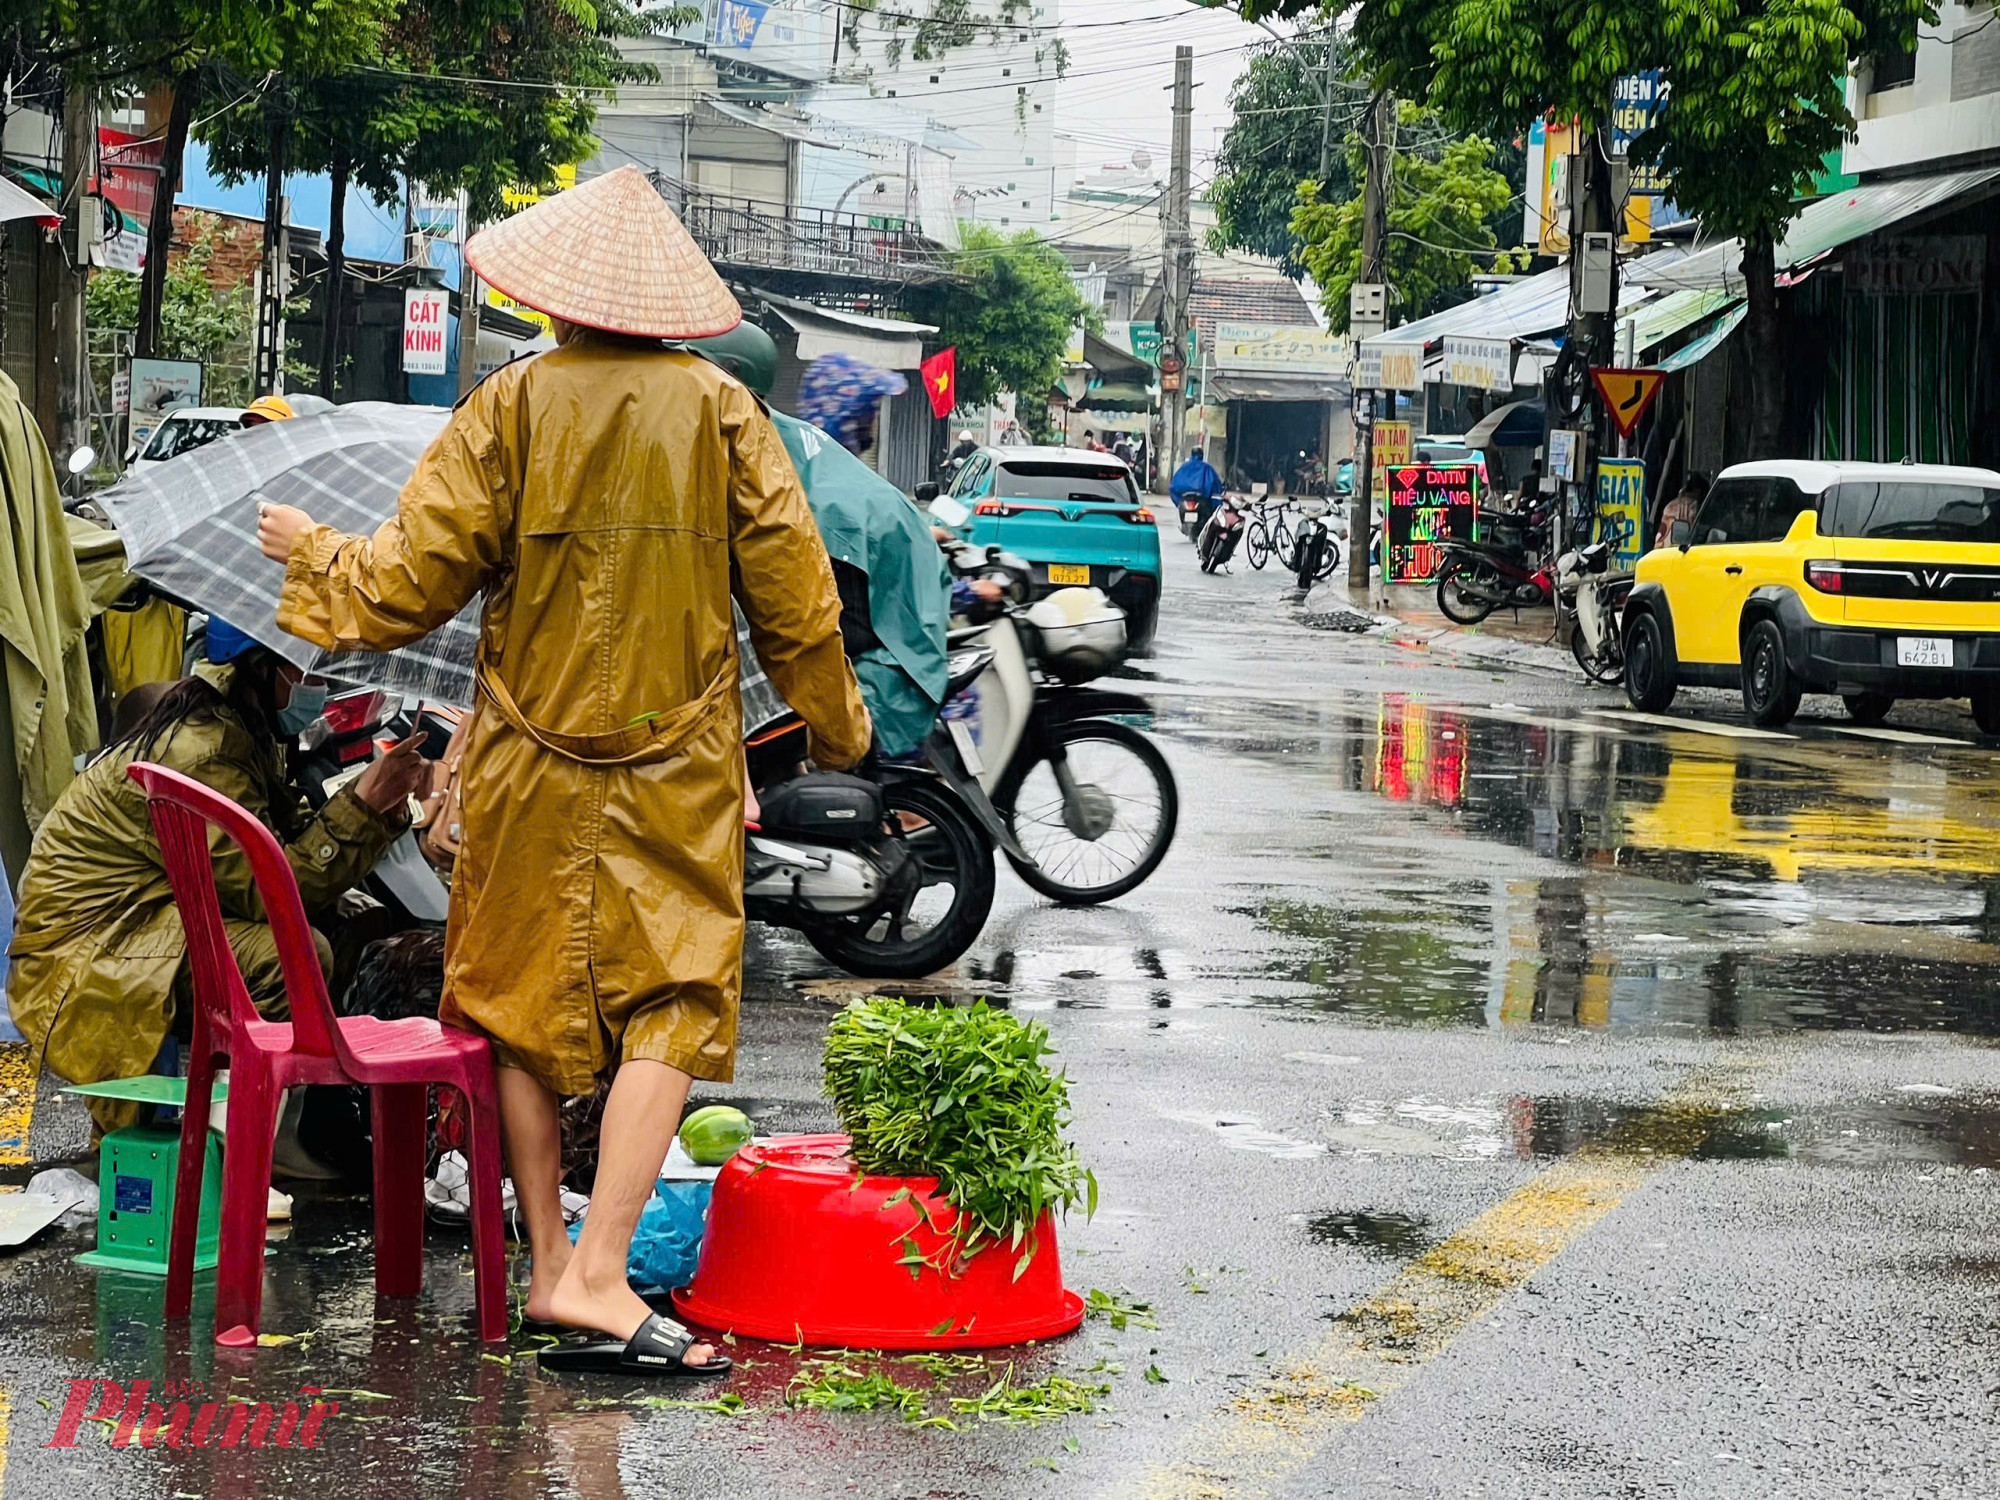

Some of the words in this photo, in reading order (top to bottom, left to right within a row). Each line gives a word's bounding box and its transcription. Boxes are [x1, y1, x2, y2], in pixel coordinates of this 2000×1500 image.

[732, 4, 756, 43] Tiger
[409, 293, 440, 323] CẮT
[405, 325, 442, 352] KÍNH
[1426, 471, 1466, 485] DNTN
[1392, 488, 1426, 507] HIỆU
[1429, 488, 1470, 505] VÀNG
[1914, 639, 1937, 651] 79A
[1904, 652, 1946, 665] 642.81
